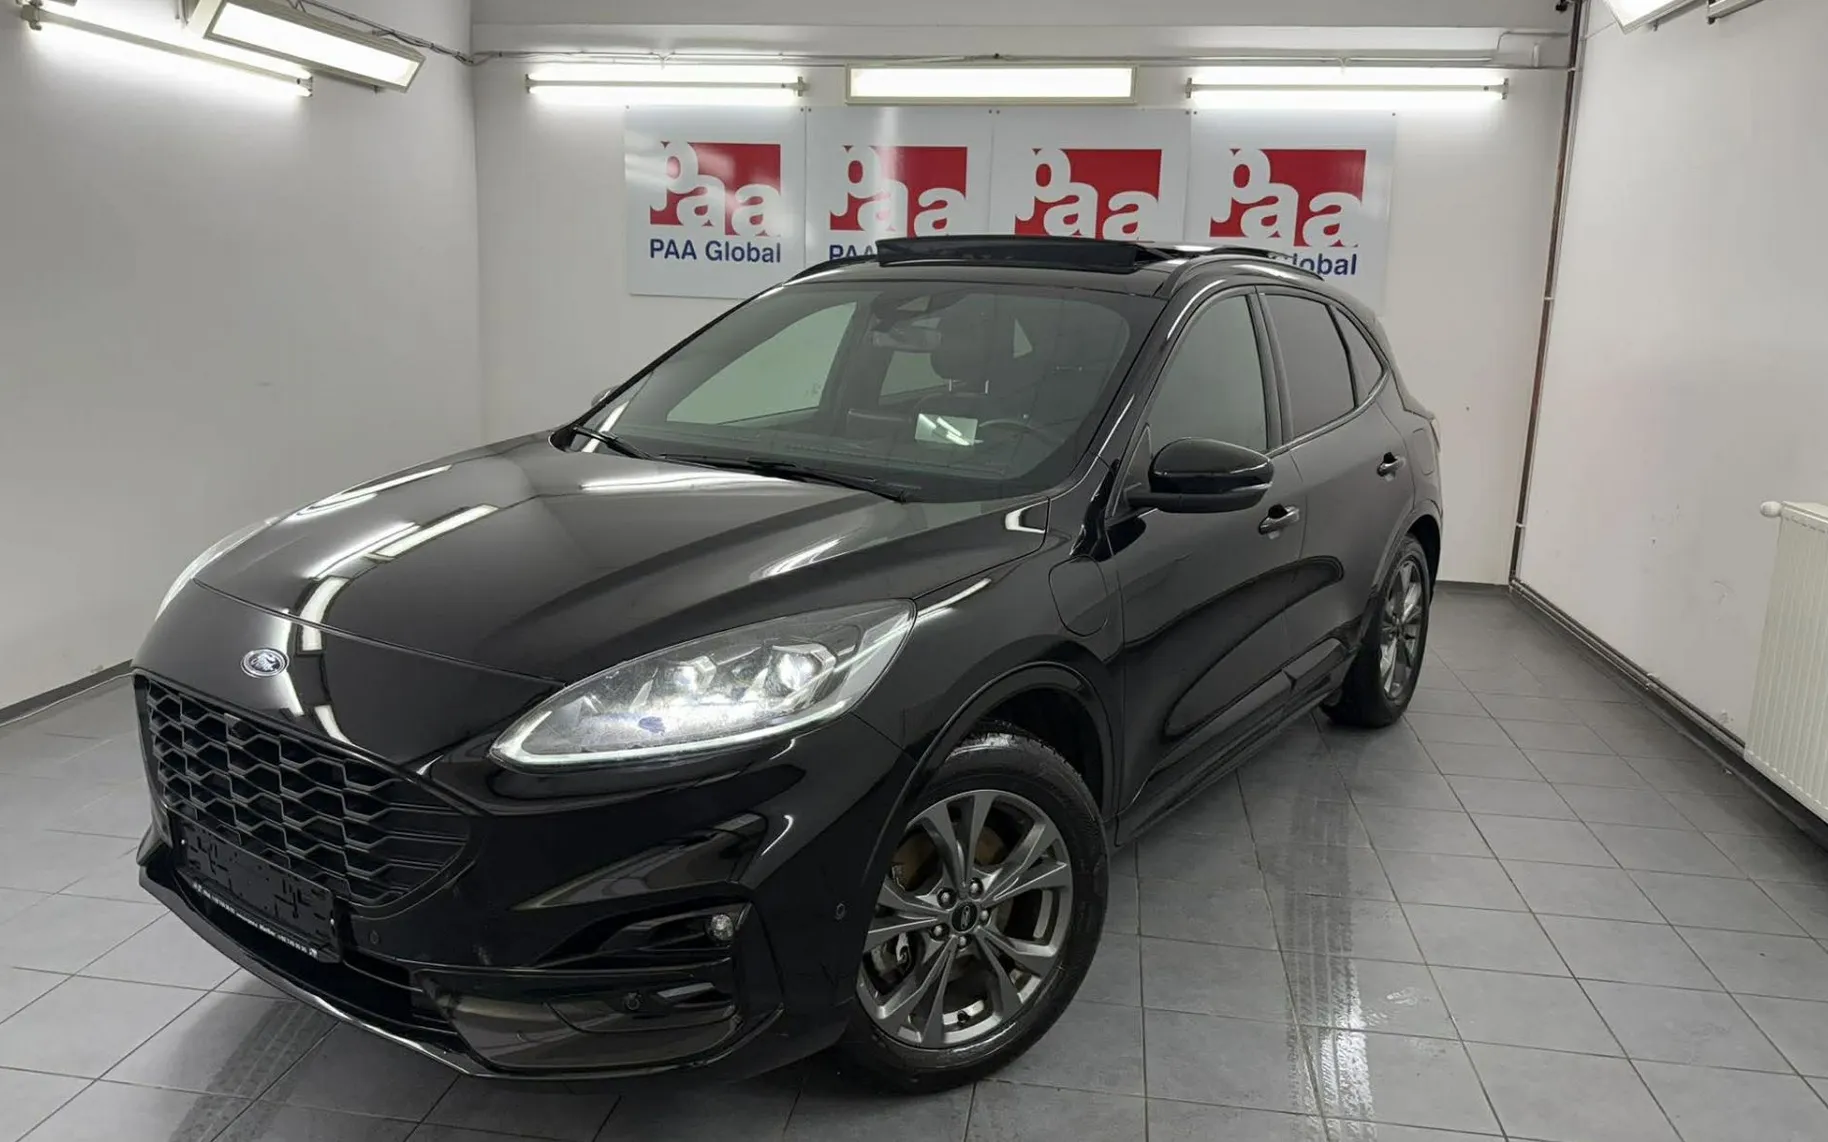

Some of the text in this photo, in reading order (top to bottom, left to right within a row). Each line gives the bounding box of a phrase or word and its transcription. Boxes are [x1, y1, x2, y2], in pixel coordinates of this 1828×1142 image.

[649, 238, 782, 263] PAA Global
[1274, 253, 1357, 275] lobal
